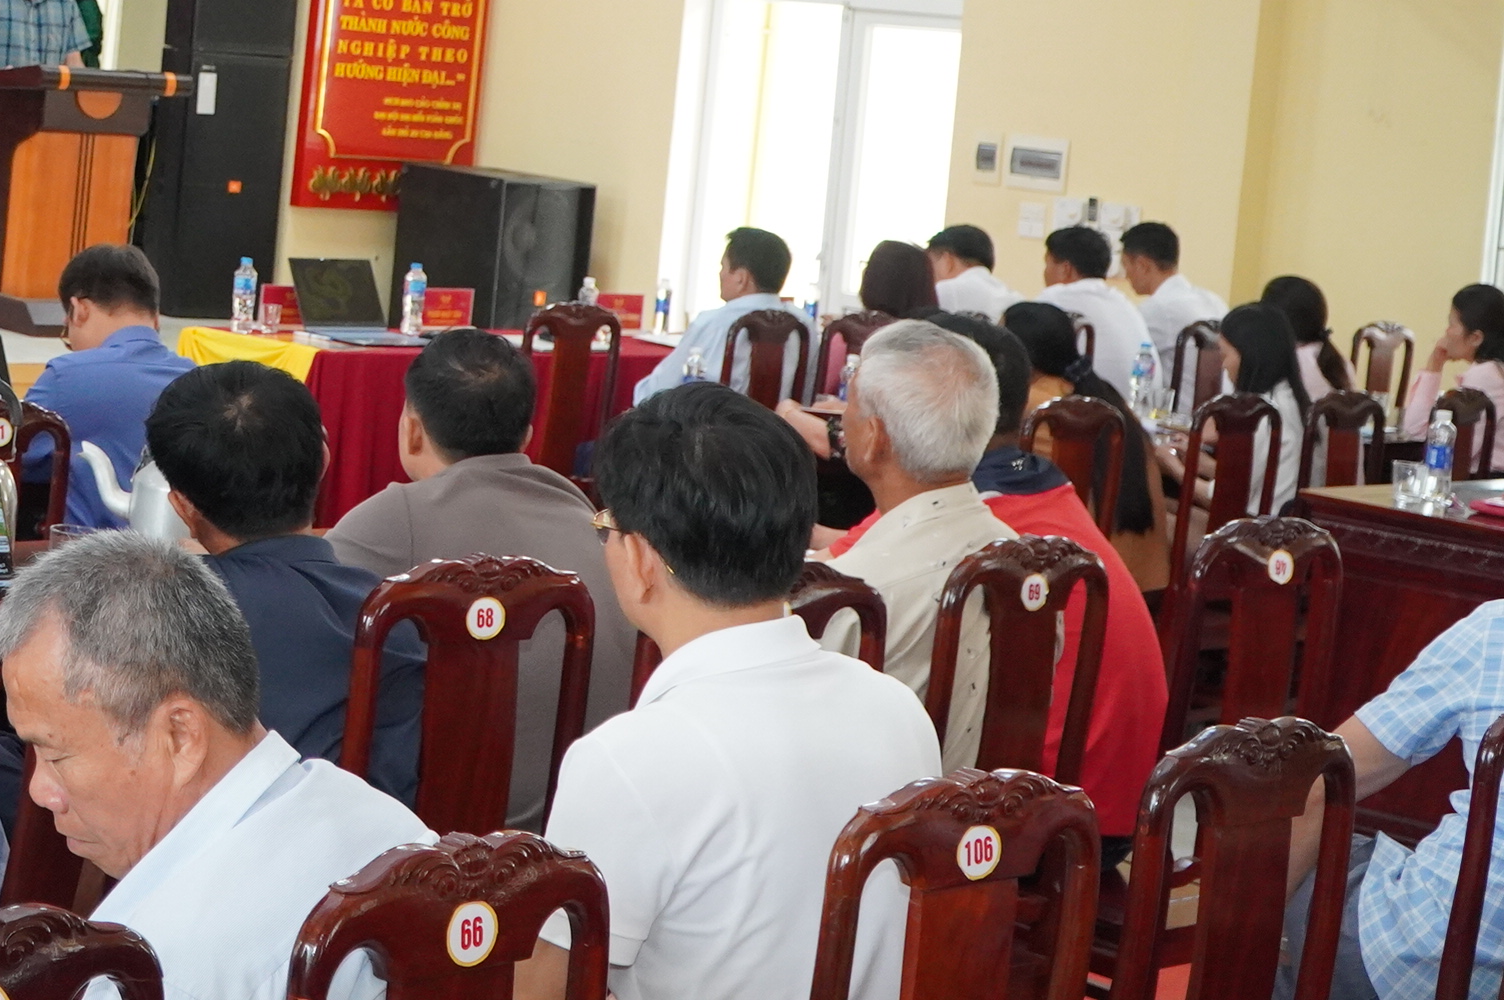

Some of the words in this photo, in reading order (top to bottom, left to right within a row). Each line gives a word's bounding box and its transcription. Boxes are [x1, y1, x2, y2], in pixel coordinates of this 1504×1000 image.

[419, 46, 468, 63] THEO
[1028, 583, 1041, 601] 69
[477, 608, 494, 628] 68
[965, 836, 994, 867] 106
[460, 916, 484, 950] 66
